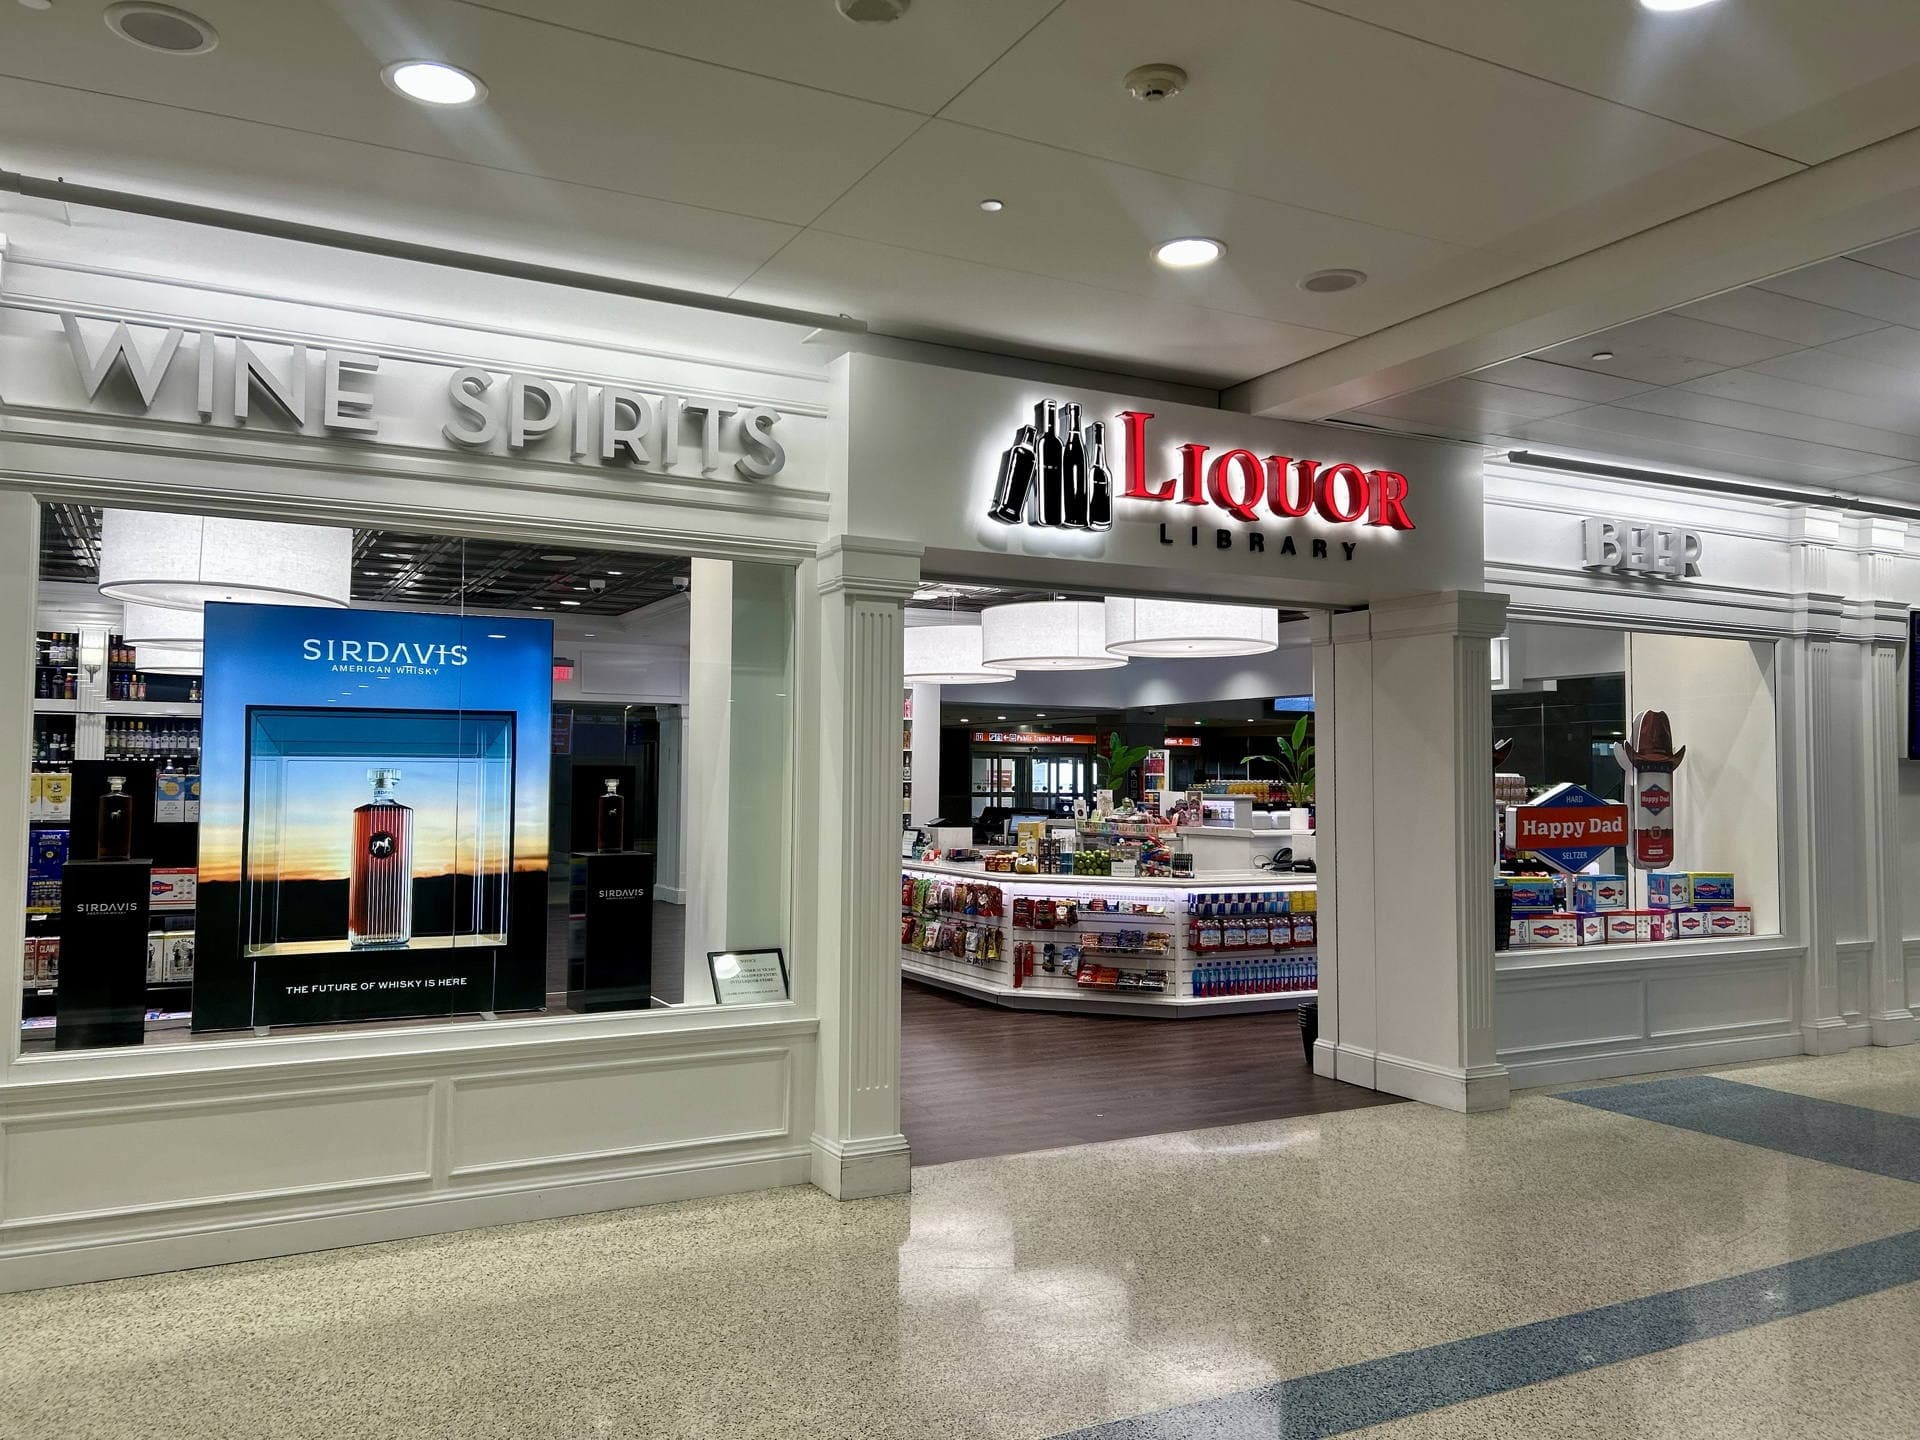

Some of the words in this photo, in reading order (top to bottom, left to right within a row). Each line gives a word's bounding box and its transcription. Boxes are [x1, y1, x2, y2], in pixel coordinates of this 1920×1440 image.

[58, 312, 380, 434] WINE
[442, 365, 785, 481] SPIRITS
[1115, 410, 1416, 530] LIQUOR
[1159, 523, 1357, 561] LIBRARY
[1581, 516, 1702, 578] BEER
[303, 638, 468, 666] SIRDAVIS
[331, 664, 391, 674] AMERICAN
[396, 666, 439, 676] WHISKY
[1566, 795, 1584, 803] HARD
[1522, 820, 1585, 839] Happy
[1588, 816, 1623, 833] Dad
[1562, 851, 1588, 860] SELTZER
[599, 888, 645, 898] SIRDAVIS
[76, 902, 138, 912] SIRDAVIS
[285, 985, 309, 995] THE
[311, 983, 358, 993] FUTURE
[360, 981, 376, 991] OF
[378, 979, 422, 990] WHISKY
[424, 979, 436, 988] IS
[438, 977, 468, 987] HERE
